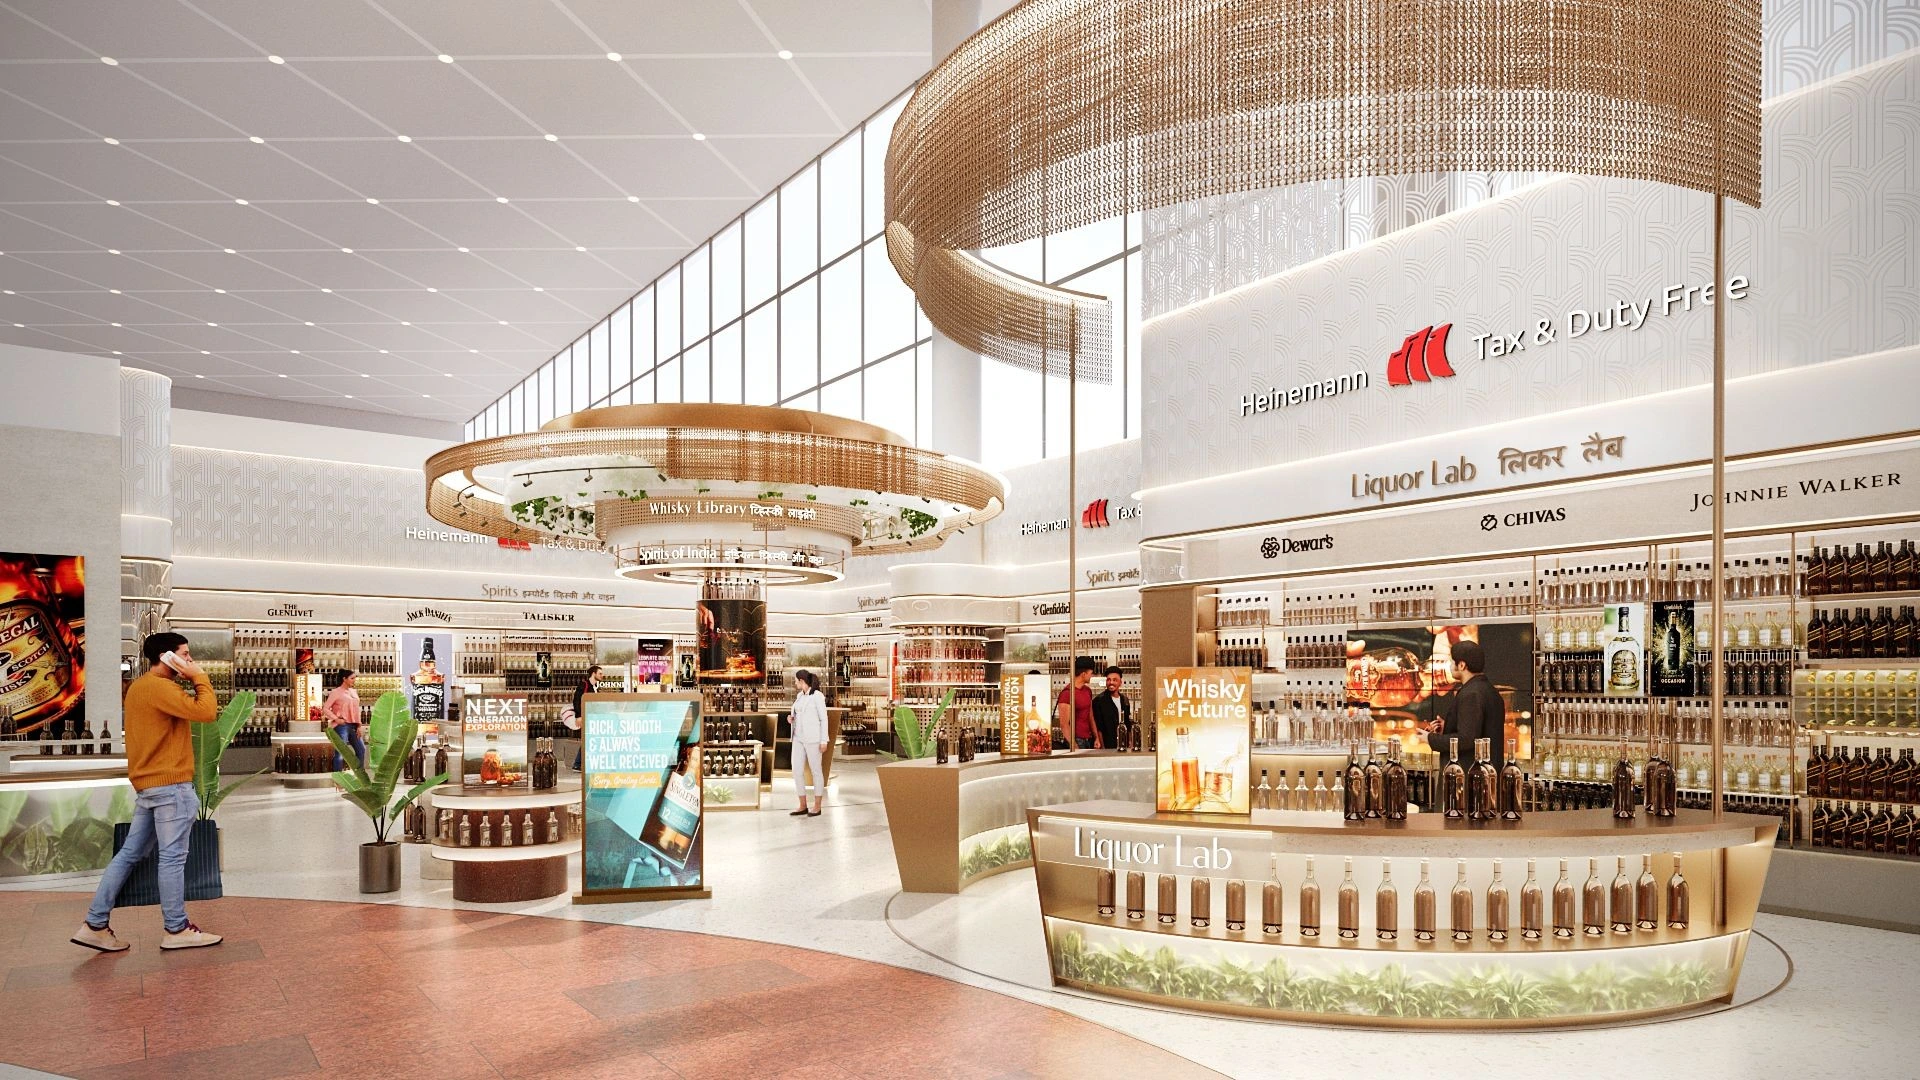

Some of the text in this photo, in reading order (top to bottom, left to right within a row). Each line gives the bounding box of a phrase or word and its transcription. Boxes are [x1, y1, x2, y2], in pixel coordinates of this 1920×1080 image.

[1240, 274, 1750, 417] Heinemann Tax & Duty Free
[1352, 432, 1626, 502] Liquor Lab लिकर लैब
[1799, 472, 1902, 497] WALKER
[650, 501, 692, 517] Whisky
[697, 501, 747, 517] Library
[1504, 507, 1567, 527] CHIVAS
[1020, 518, 1071, 536] Heineman
[1115, 506, 1136, 520] Tax
[405, 526, 607, 554] Heinemann Tax & Duty
[1282, 534, 1334, 554] Dewar's
[639, 546, 669, 562] Spirits
[671, 548, 684, 560] of
[687, 546, 717, 560] India
[1086, 570, 1115, 587] Spirits
[481, 583, 518, 598] Spirits
[267, 608, 315, 618] GLENLIVET
[407, 610, 424, 622] JACK
[522, 611, 575, 622] TALISKER
[0, 616, 39, 644] EGAL
[11, 643, 50, 671] SCOTCH
[1163, 678, 1246, 702] Whisky
[466, 698, 527, 716] NEXT
[1168, 700, 1177, 709] of
[1178, 700, 1246, 718] Future
[466, 716, 527, 724] GENERATION
[1010, 676, 1020, 752] INNOVATION
[466, 723, 527, 732] EXPLORATION
[589, 720, 662, 736] RICH, SMOOTH
[589, 736, 640, 752] & ALWAYS
[589, 754, 668, 770] WELL RECEIVED
[662, 806, 671, 820] 12
[1074, 826, 1233, 871] Liquor Lab
